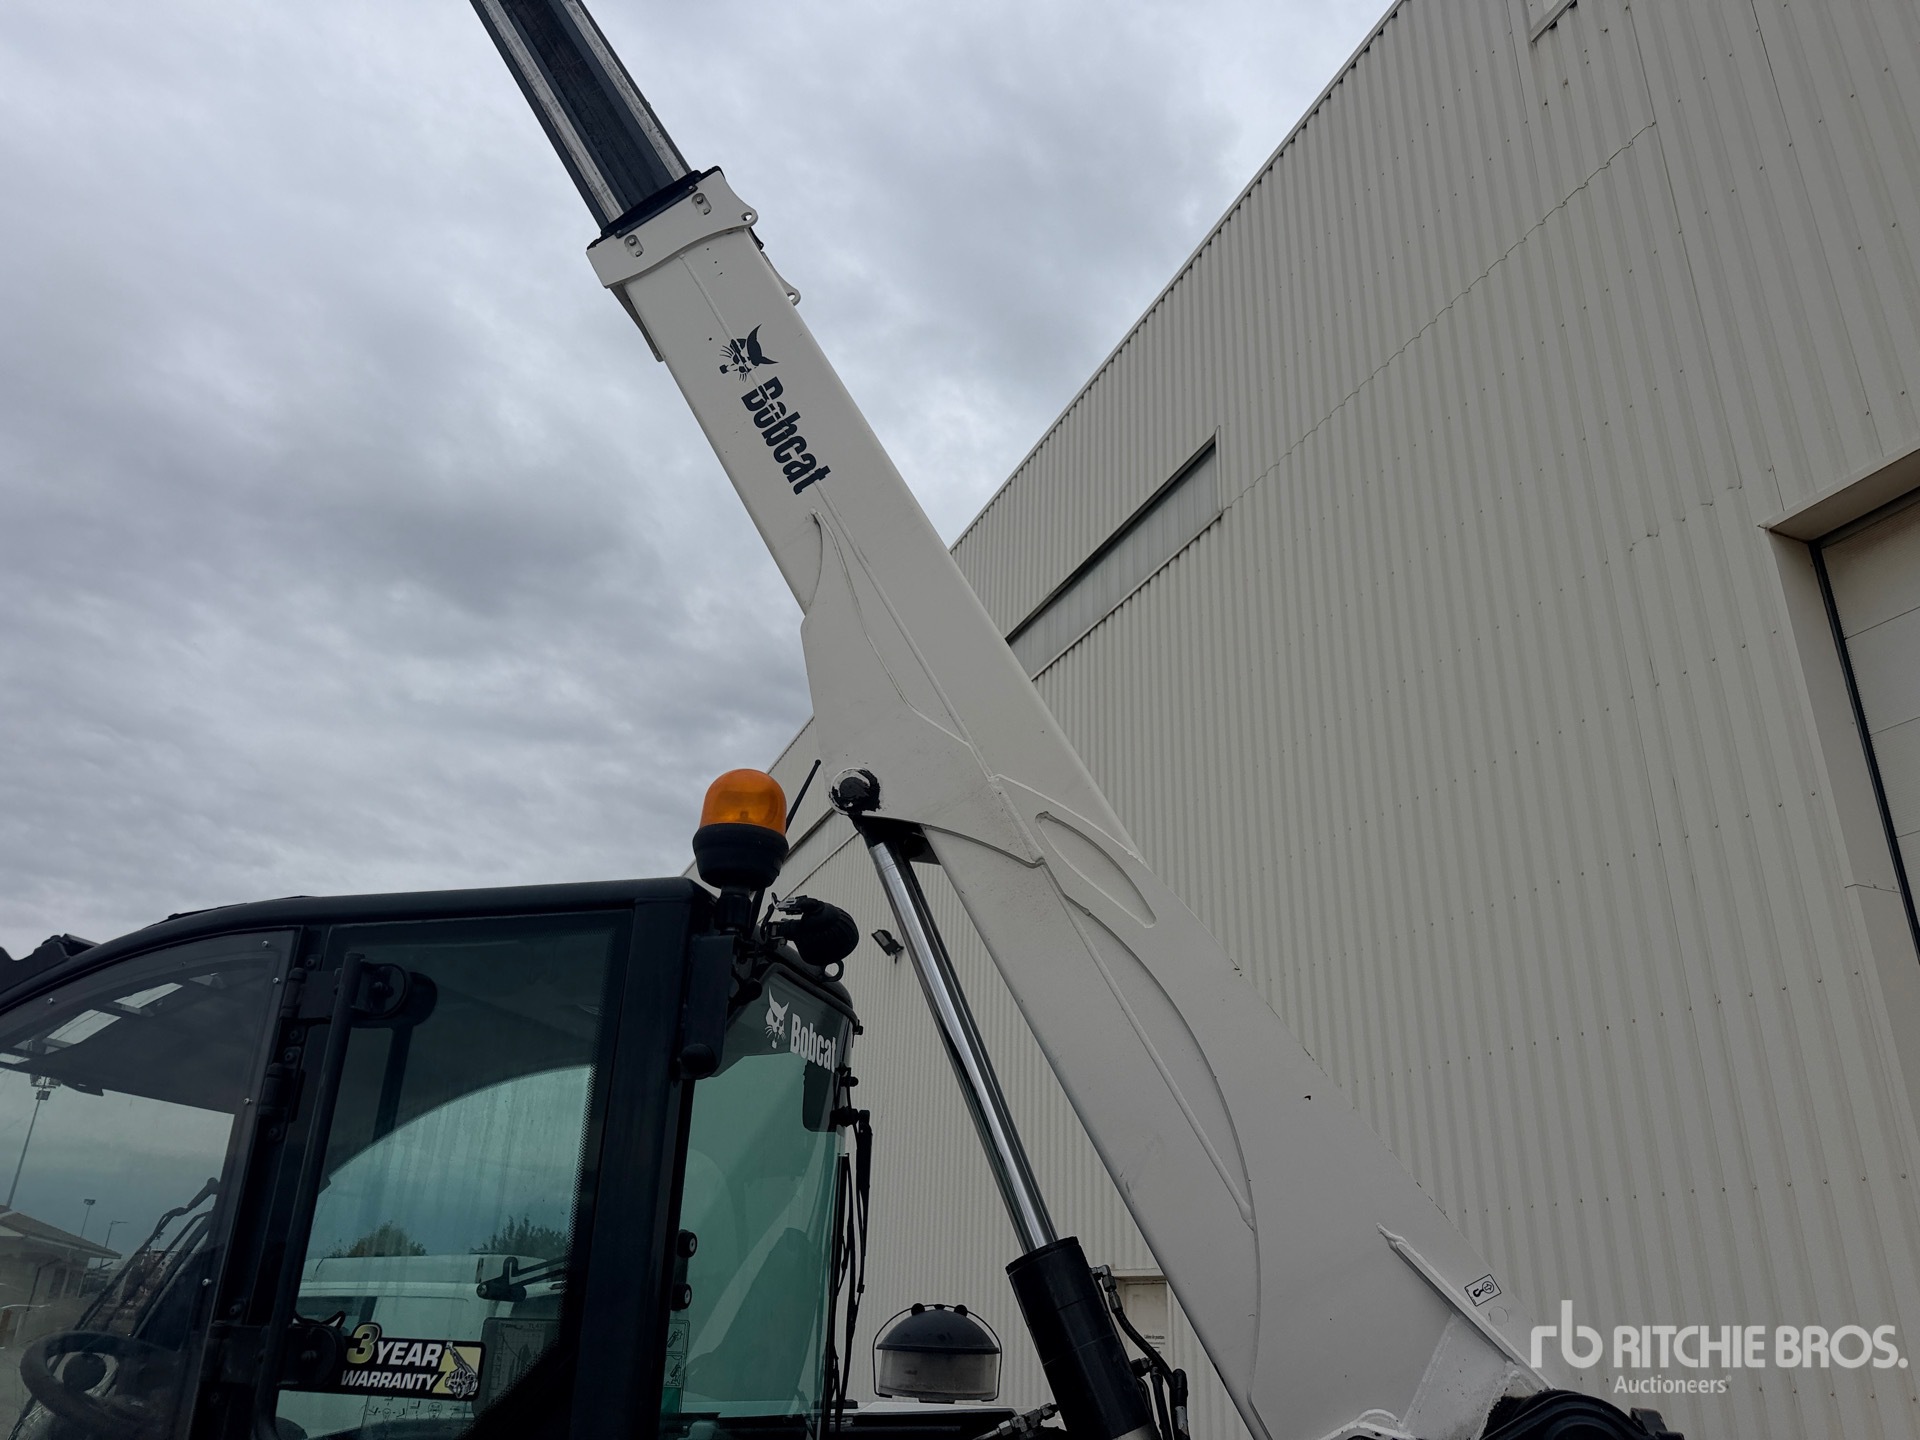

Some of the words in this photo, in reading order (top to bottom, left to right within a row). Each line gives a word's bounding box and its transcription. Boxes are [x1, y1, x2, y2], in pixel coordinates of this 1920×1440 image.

[741, 376, 831, 495] Bobcat
[790, 1013, 836, 1073] Bobcat
[346, 1323, 381, 1364] 3
[376, 1340, 443, 1367] YEAR
[340, 1369, 438, 1391] WARRANTY
